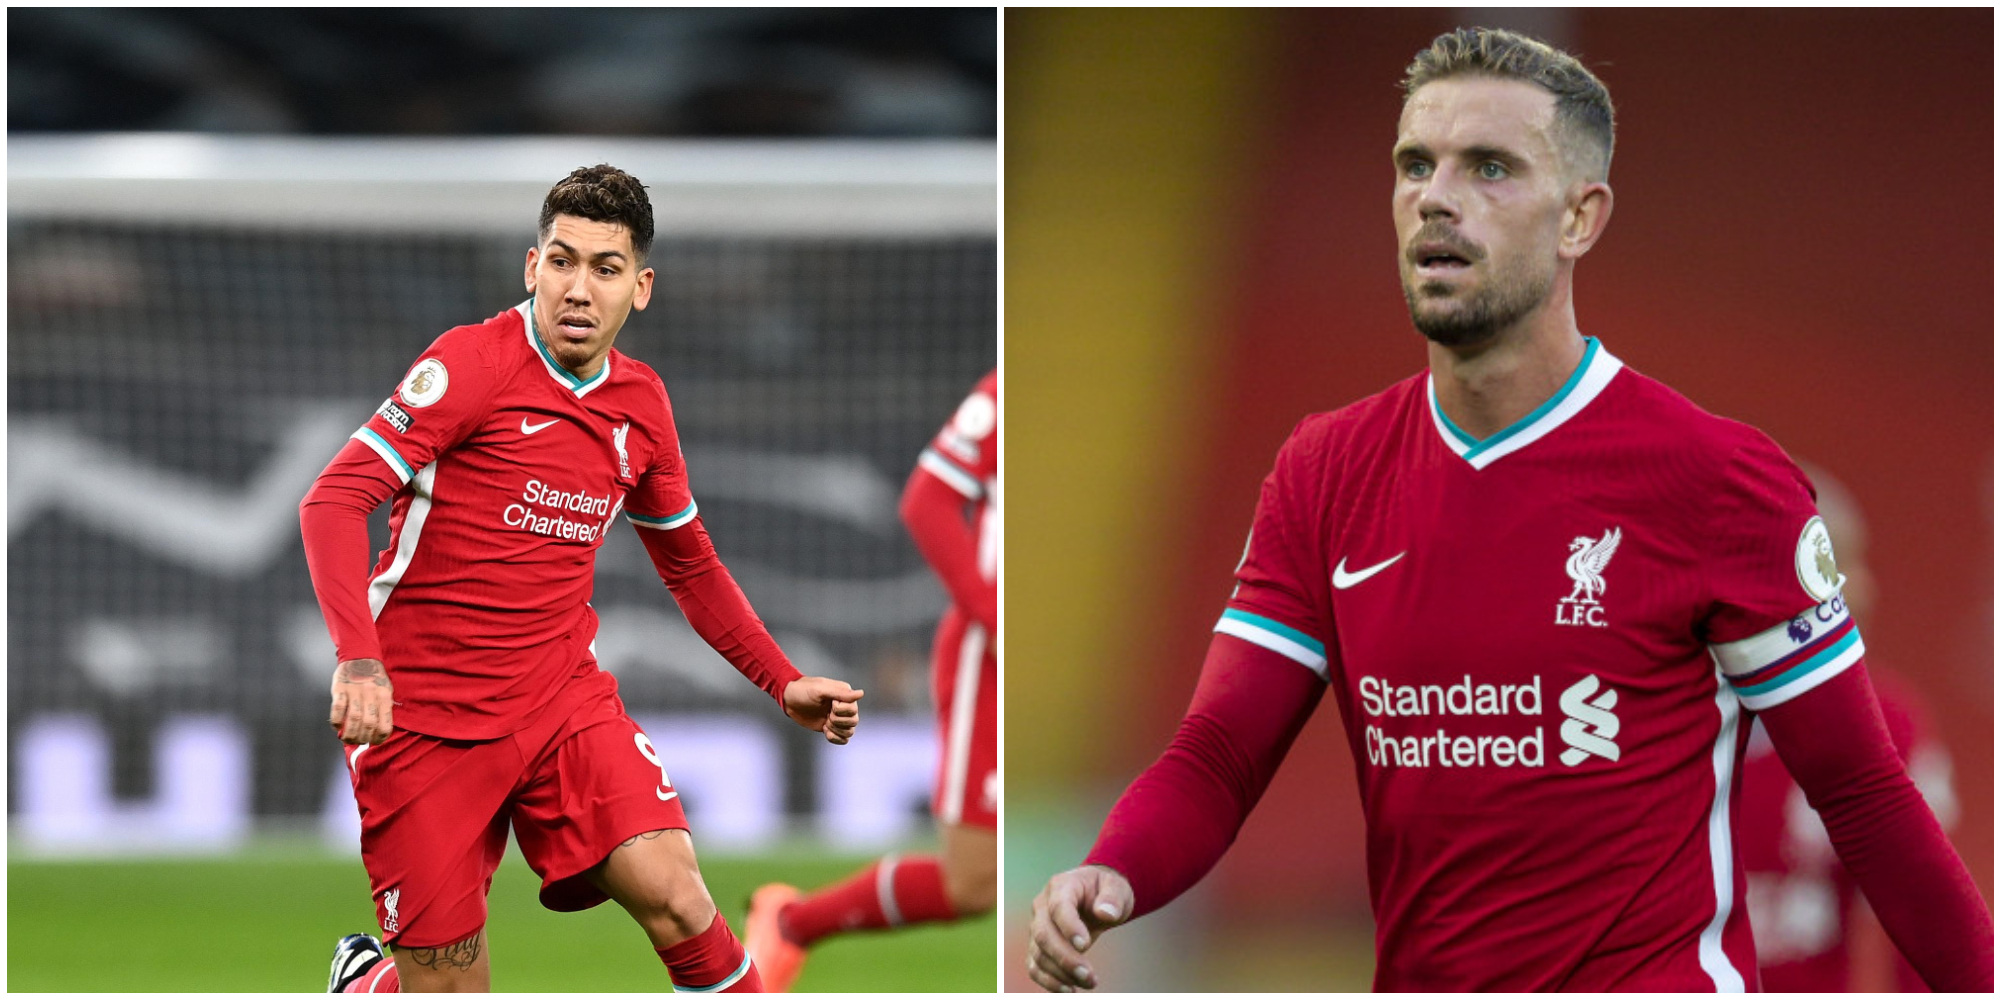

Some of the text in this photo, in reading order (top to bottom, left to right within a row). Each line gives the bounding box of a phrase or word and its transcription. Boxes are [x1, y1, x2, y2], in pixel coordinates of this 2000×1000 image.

[523, 479, 610, 516] Standard
[503, 504, 602, 542] Chartered
[1359, 673, 1543, 717] Standard
[634, 732, 672, 788] 9
[1365, 725, 1545, 768] Chartered
